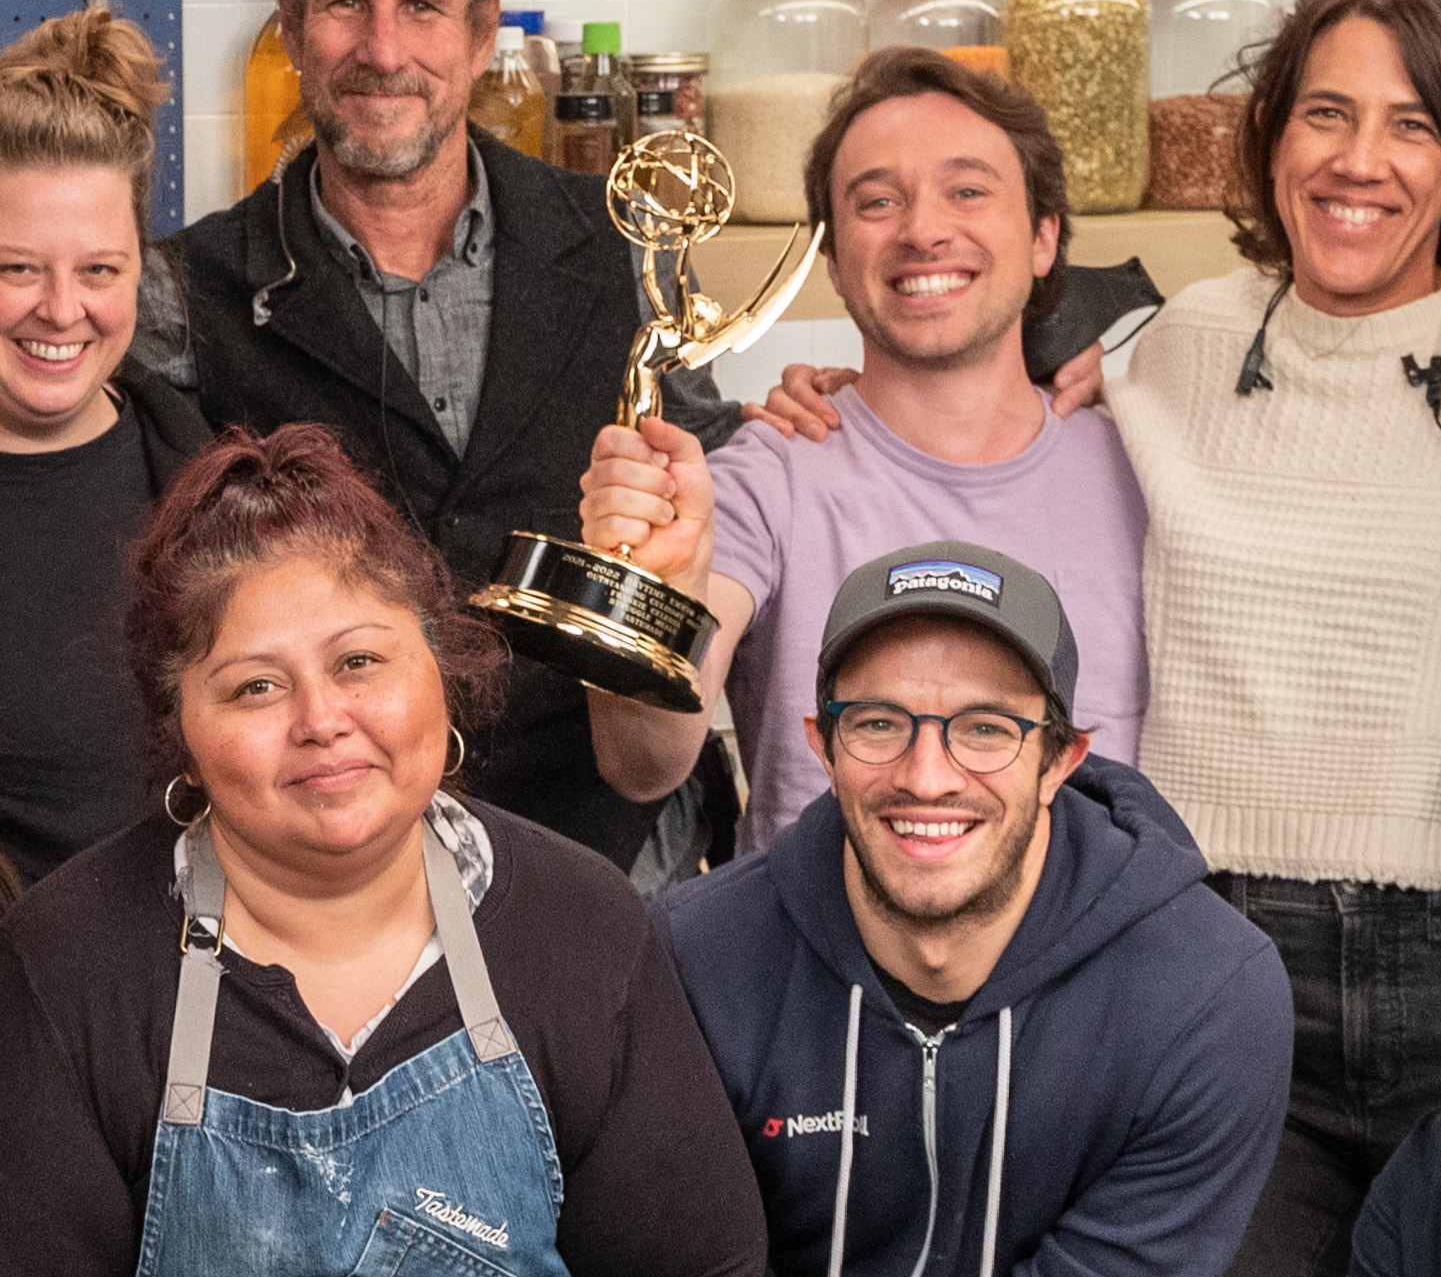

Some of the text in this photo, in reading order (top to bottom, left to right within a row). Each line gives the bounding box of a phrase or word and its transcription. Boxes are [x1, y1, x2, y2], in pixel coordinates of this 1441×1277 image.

[592, 564, 620, 579] 2022
[893, 577, 994, 601] patagonia
[415, 1187, 510, 1249] Tastemade
